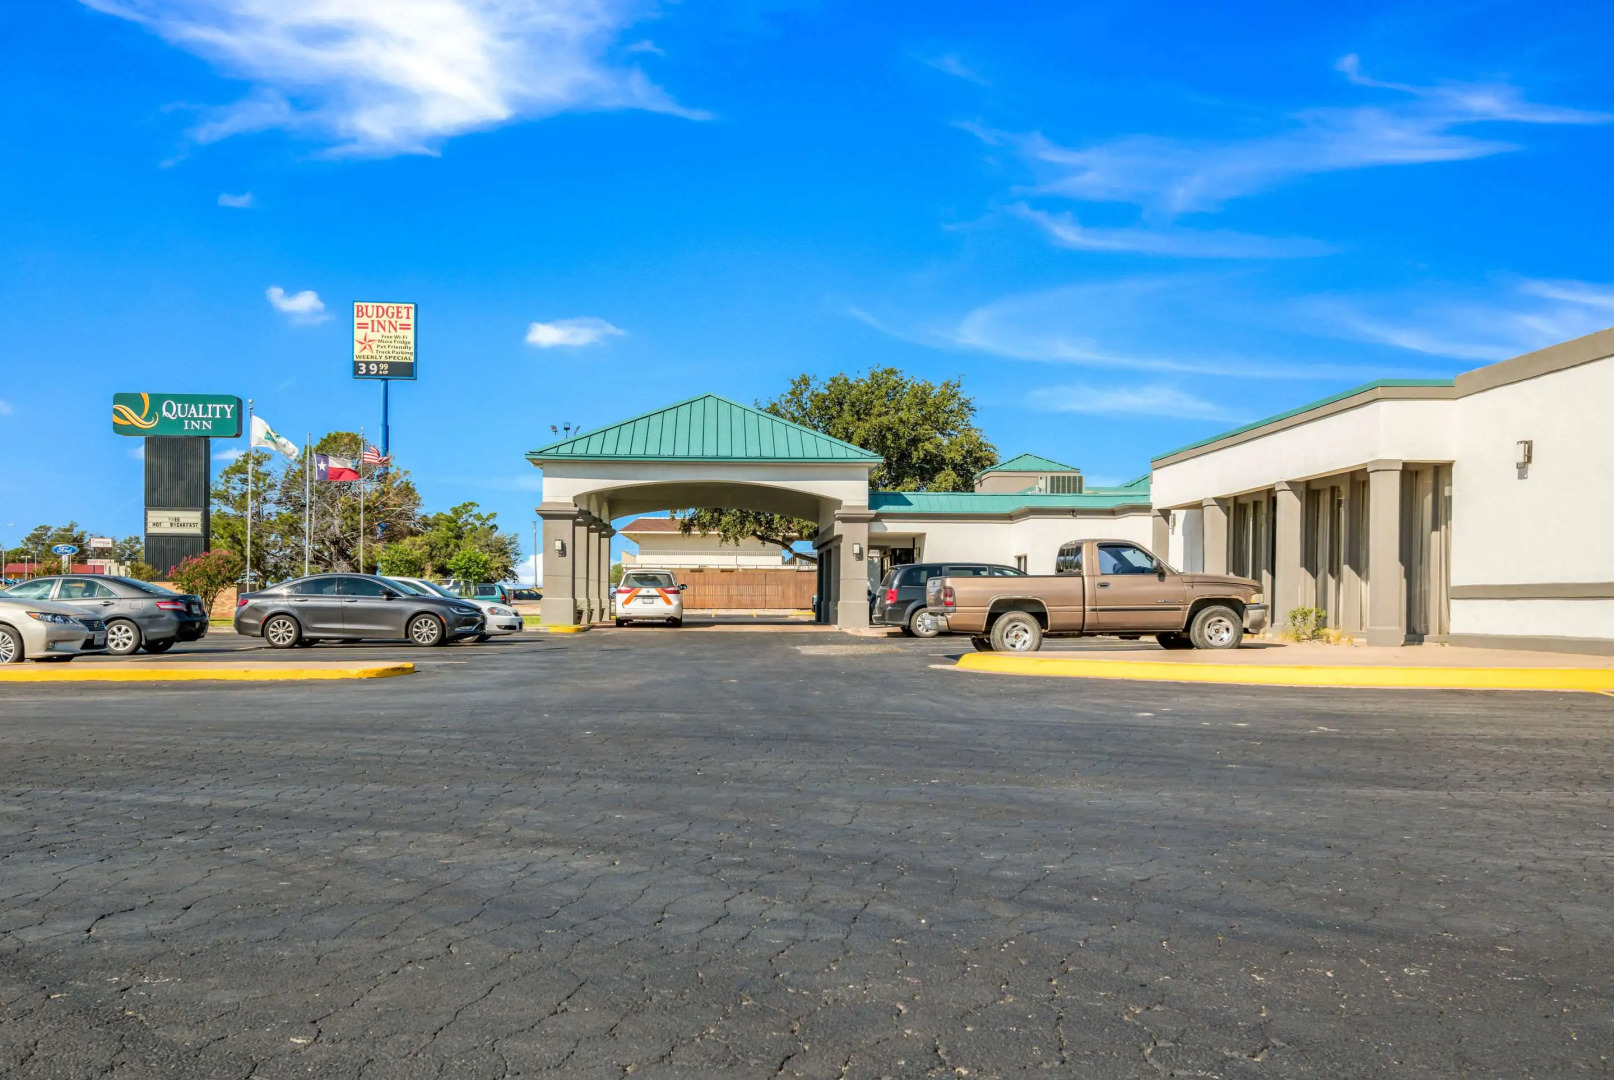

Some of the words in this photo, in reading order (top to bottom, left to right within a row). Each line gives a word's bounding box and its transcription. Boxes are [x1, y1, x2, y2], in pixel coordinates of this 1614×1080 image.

[356, 305, 413, 319] BUDGET
[371, 319, 398, 333] INN
[162, 400, 234, 420] QUALITY
[184, 420, 212, 430] INN
